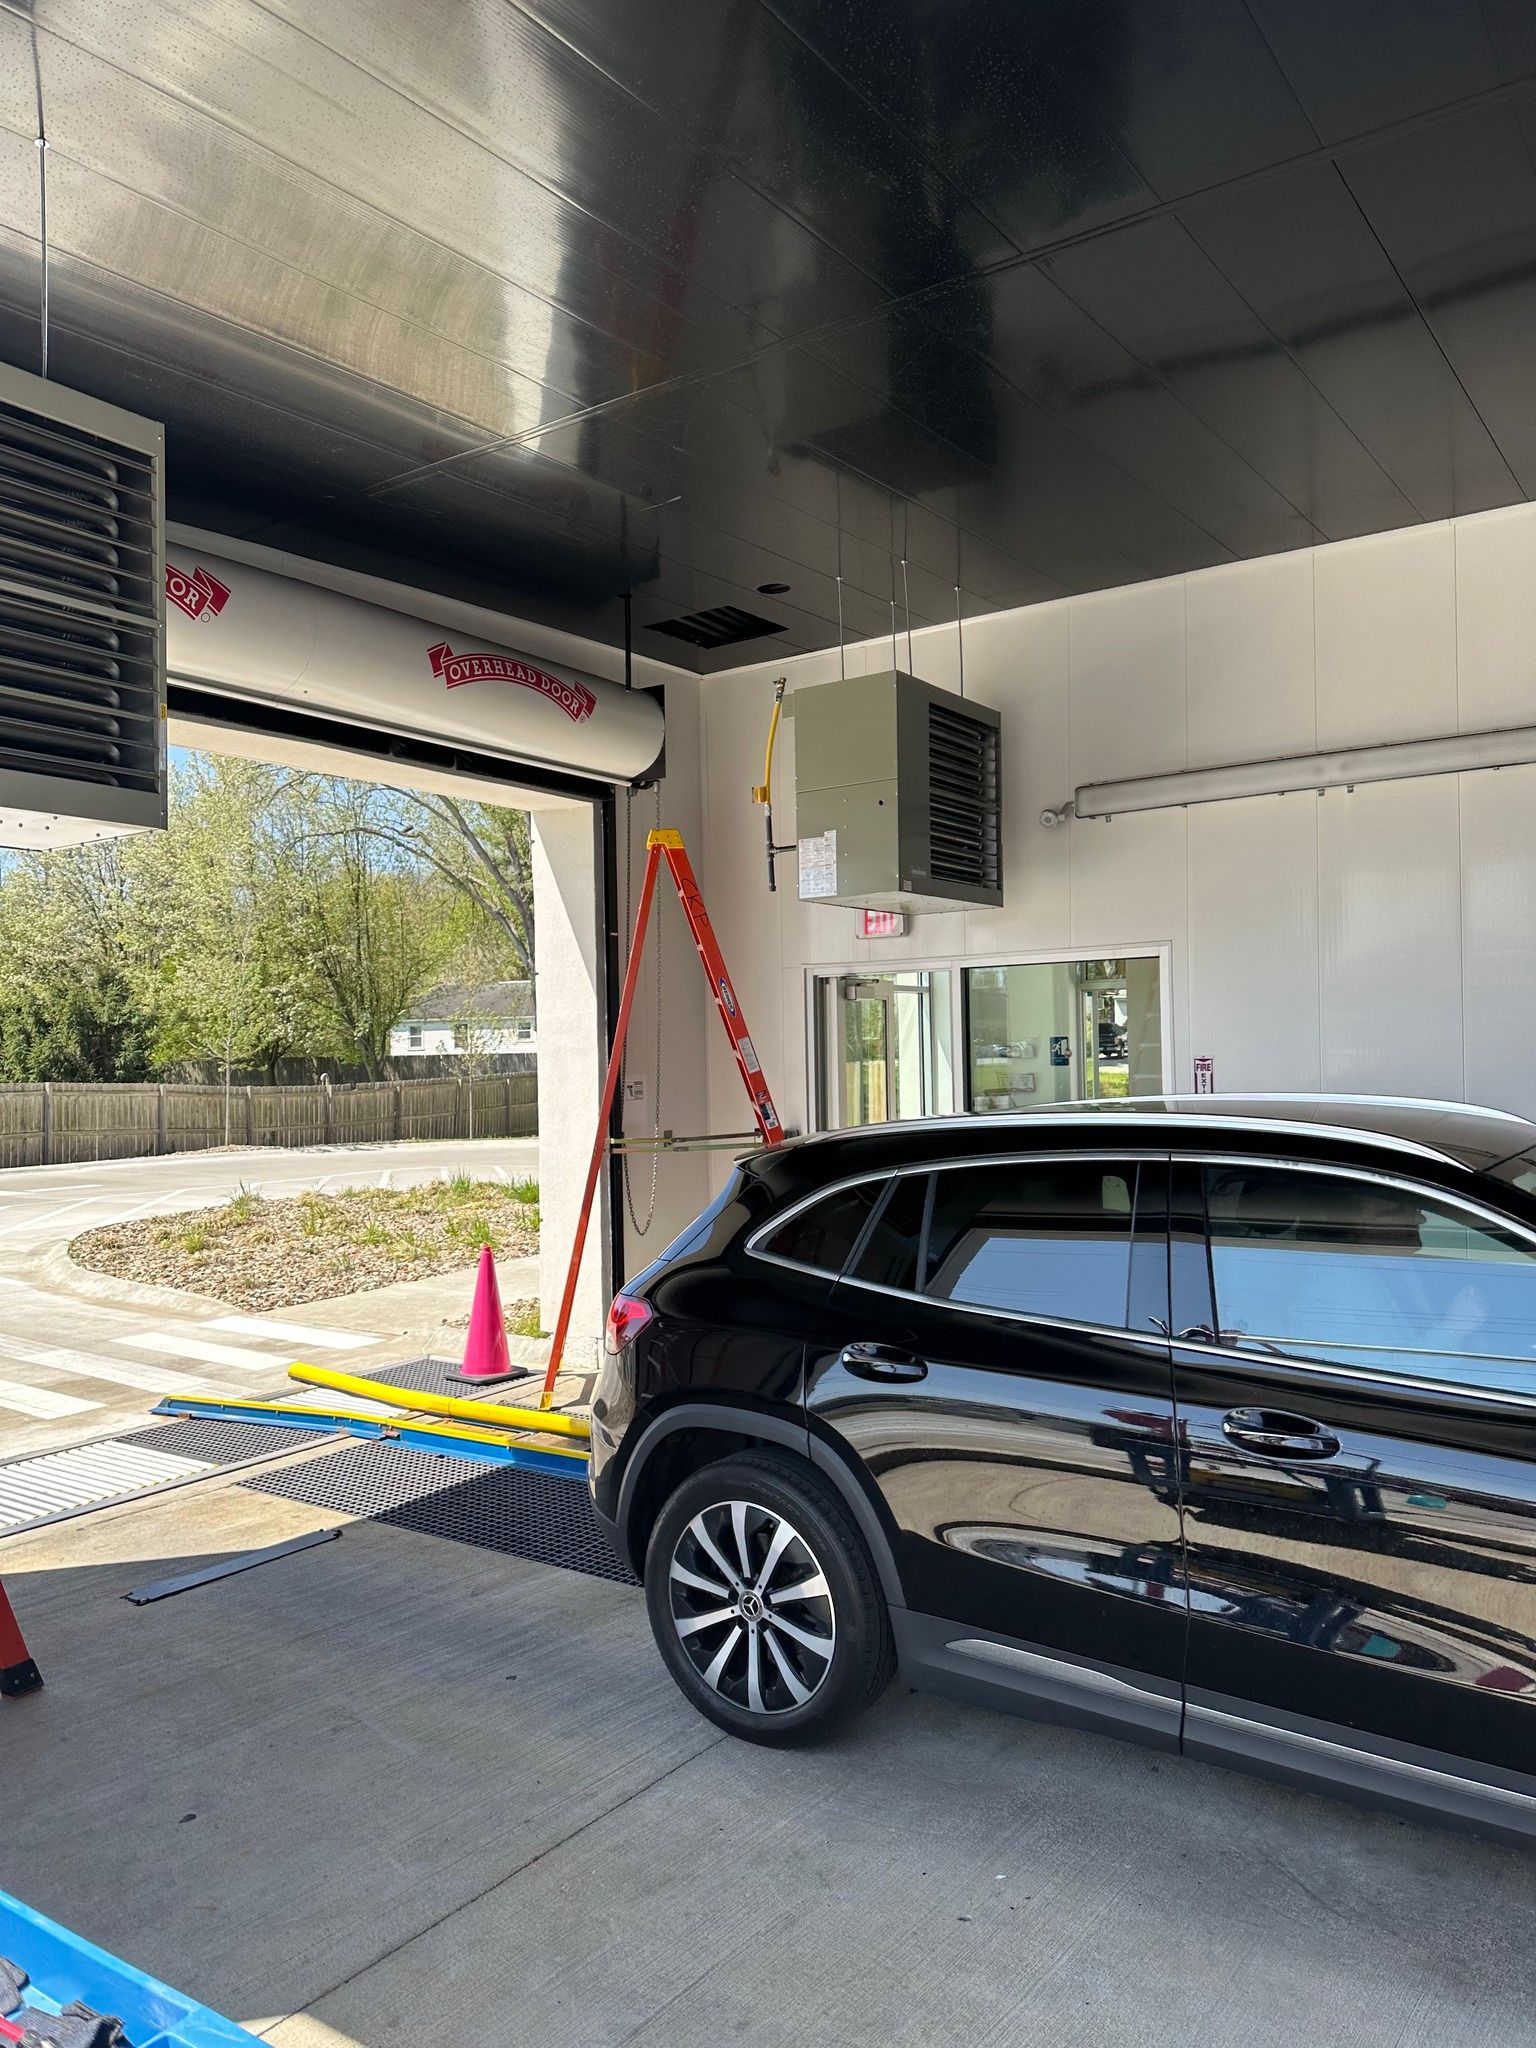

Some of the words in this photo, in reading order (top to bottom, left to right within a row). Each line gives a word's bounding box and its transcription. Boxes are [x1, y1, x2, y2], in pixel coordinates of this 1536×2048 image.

[166, 572, 200, 610] OR
[449, 659, 537, 683] OVERHEAD
[541, 676, 580, 715] DOOR
[1196, 1063, 1212, 1072] FIRE
